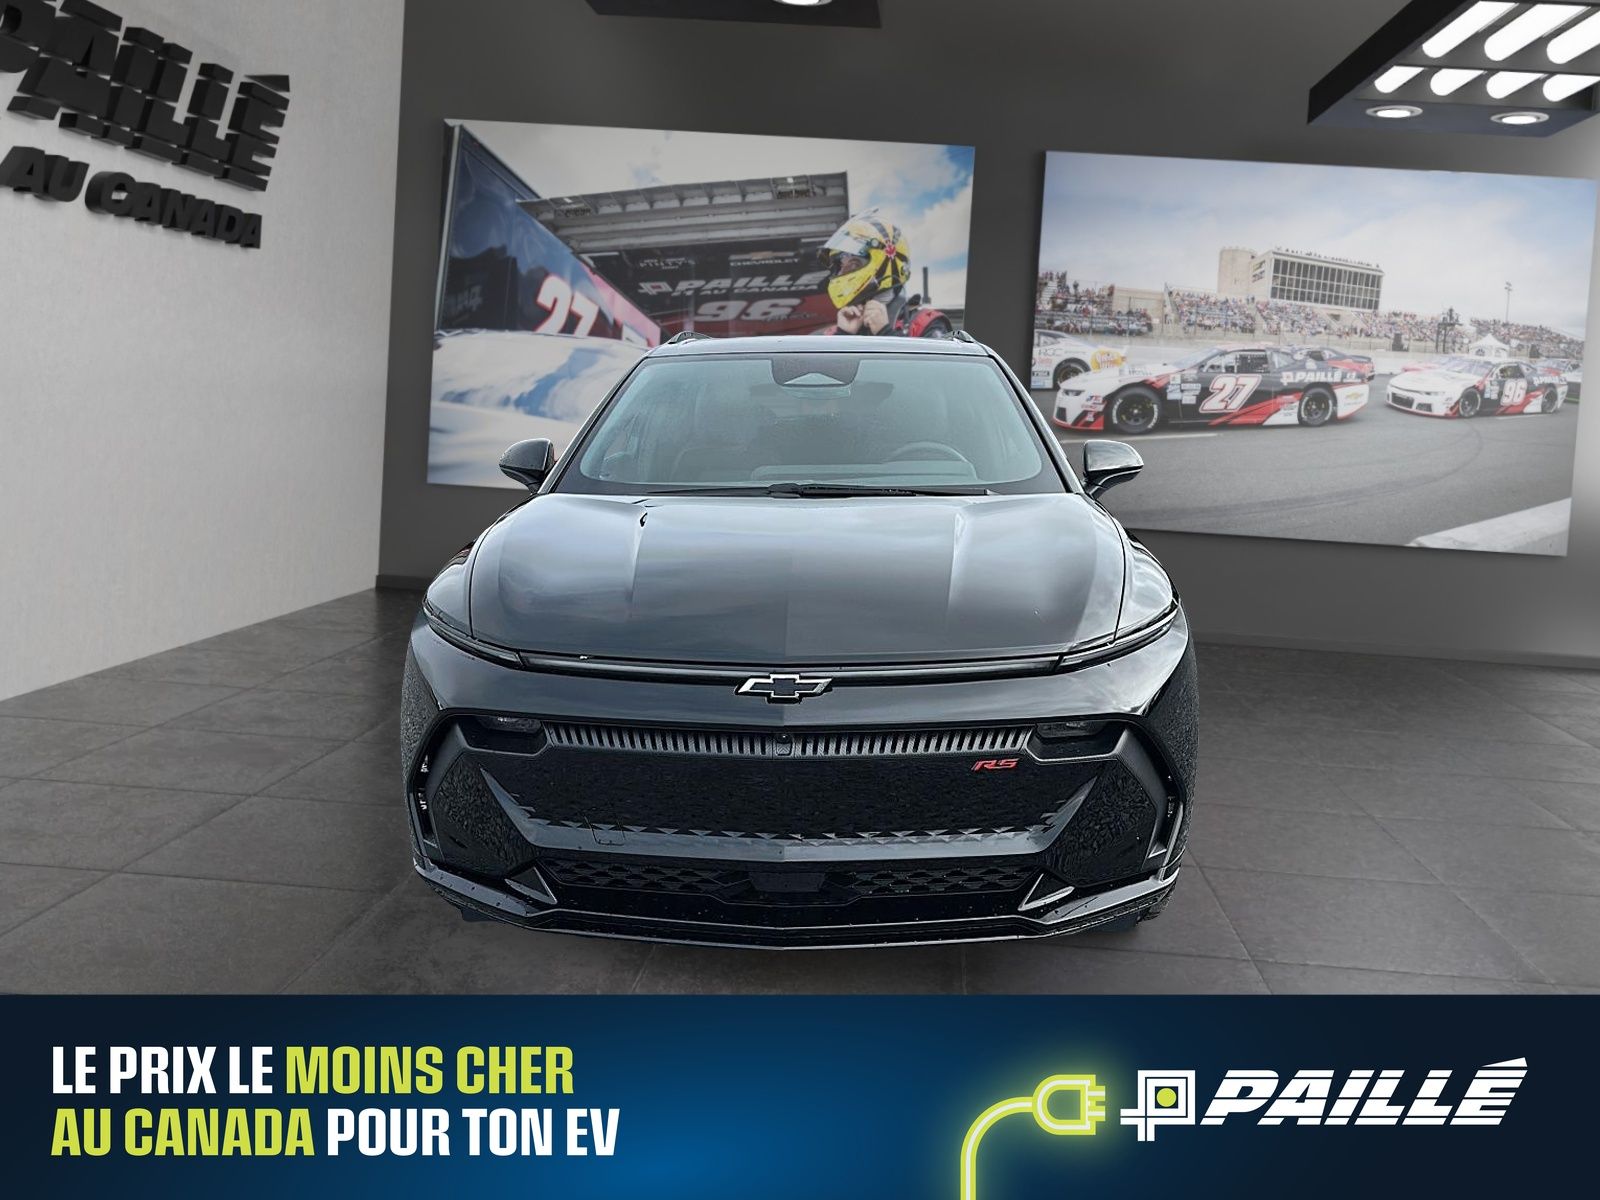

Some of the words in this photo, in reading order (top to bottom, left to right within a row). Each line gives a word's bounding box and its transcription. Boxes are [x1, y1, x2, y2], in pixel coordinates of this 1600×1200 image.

[0, 146, 90, 202] AU
[84, 171, 262, 248] CANADA
[733, 284, 819, 294] CANADA
[693, 298, 803, 323] 96
[1199, 373, 1263, 413] 27
[1501, 378, 1528, 407] 96
[970, 758, 1019, 772] RS
